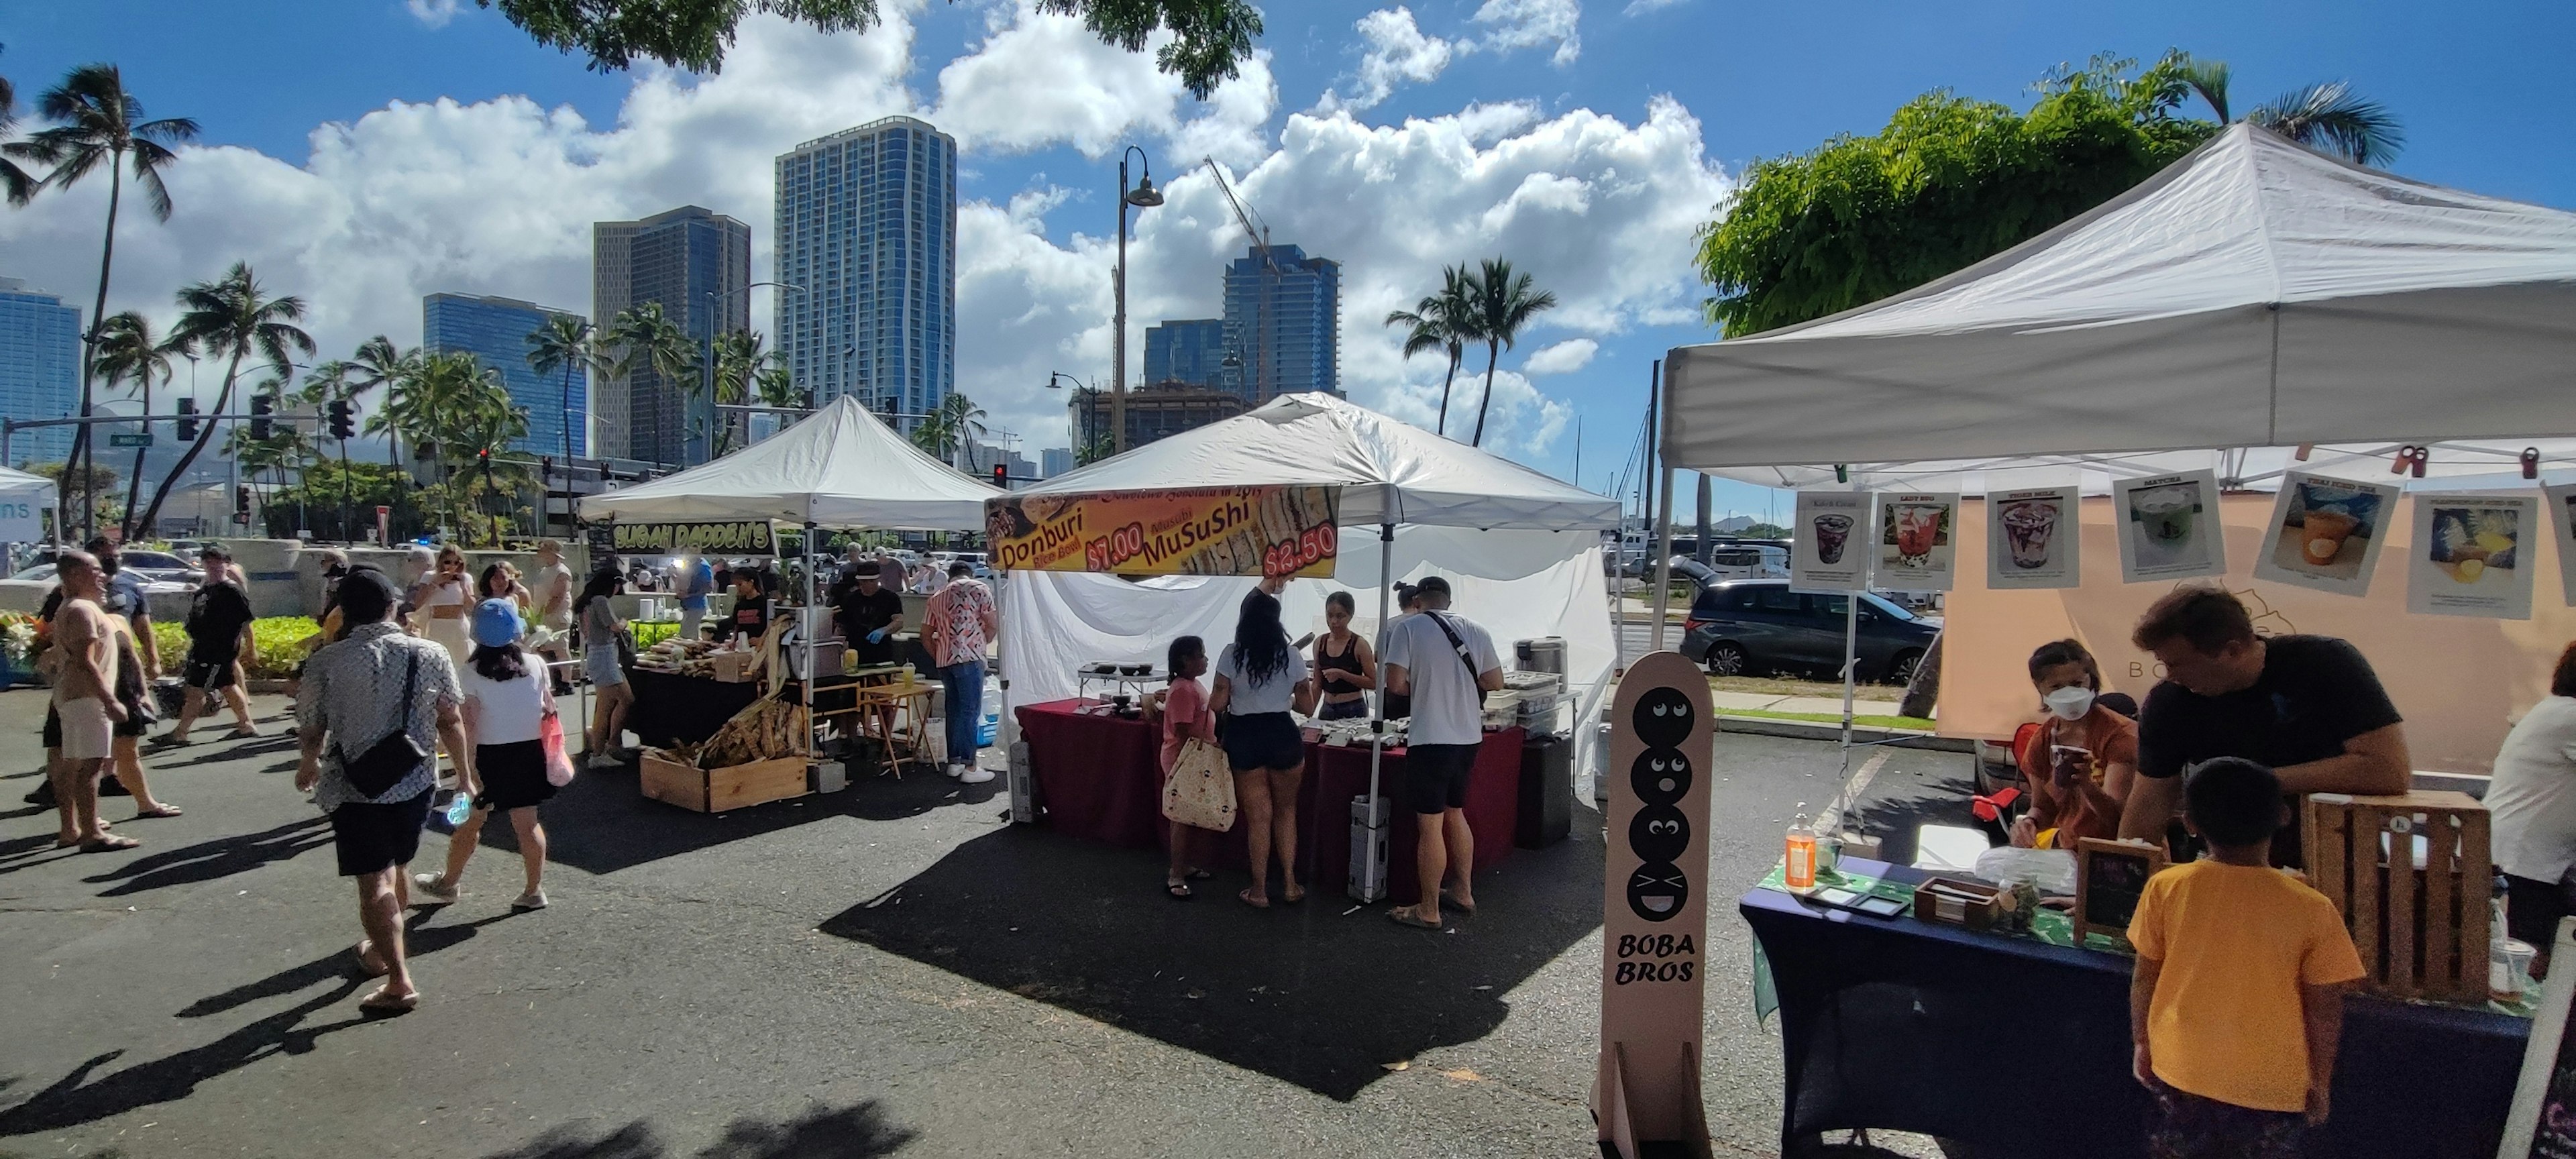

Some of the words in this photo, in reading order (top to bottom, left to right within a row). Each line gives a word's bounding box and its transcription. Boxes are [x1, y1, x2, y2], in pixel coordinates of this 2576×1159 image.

[2144, 476, 2182, 486] MATCHA
[1143, 495, 1249, 567] MuSuShi
[1151, 508, 1193, 533] Musubi
[613, 525, 672, 549] SUGAH
[1002, 507, 1082, 568] Donburi
[1086, 522, 1143, 571] $7.00
[1265, 522, 1336, 575] $2.50
[1033, 551, 1057, 569] Rice
[1057, 536, 1082, 558] Bowl
[1617, 934, 1695, 958] BOBA
[1615, 962, 1694, 985] BROS
